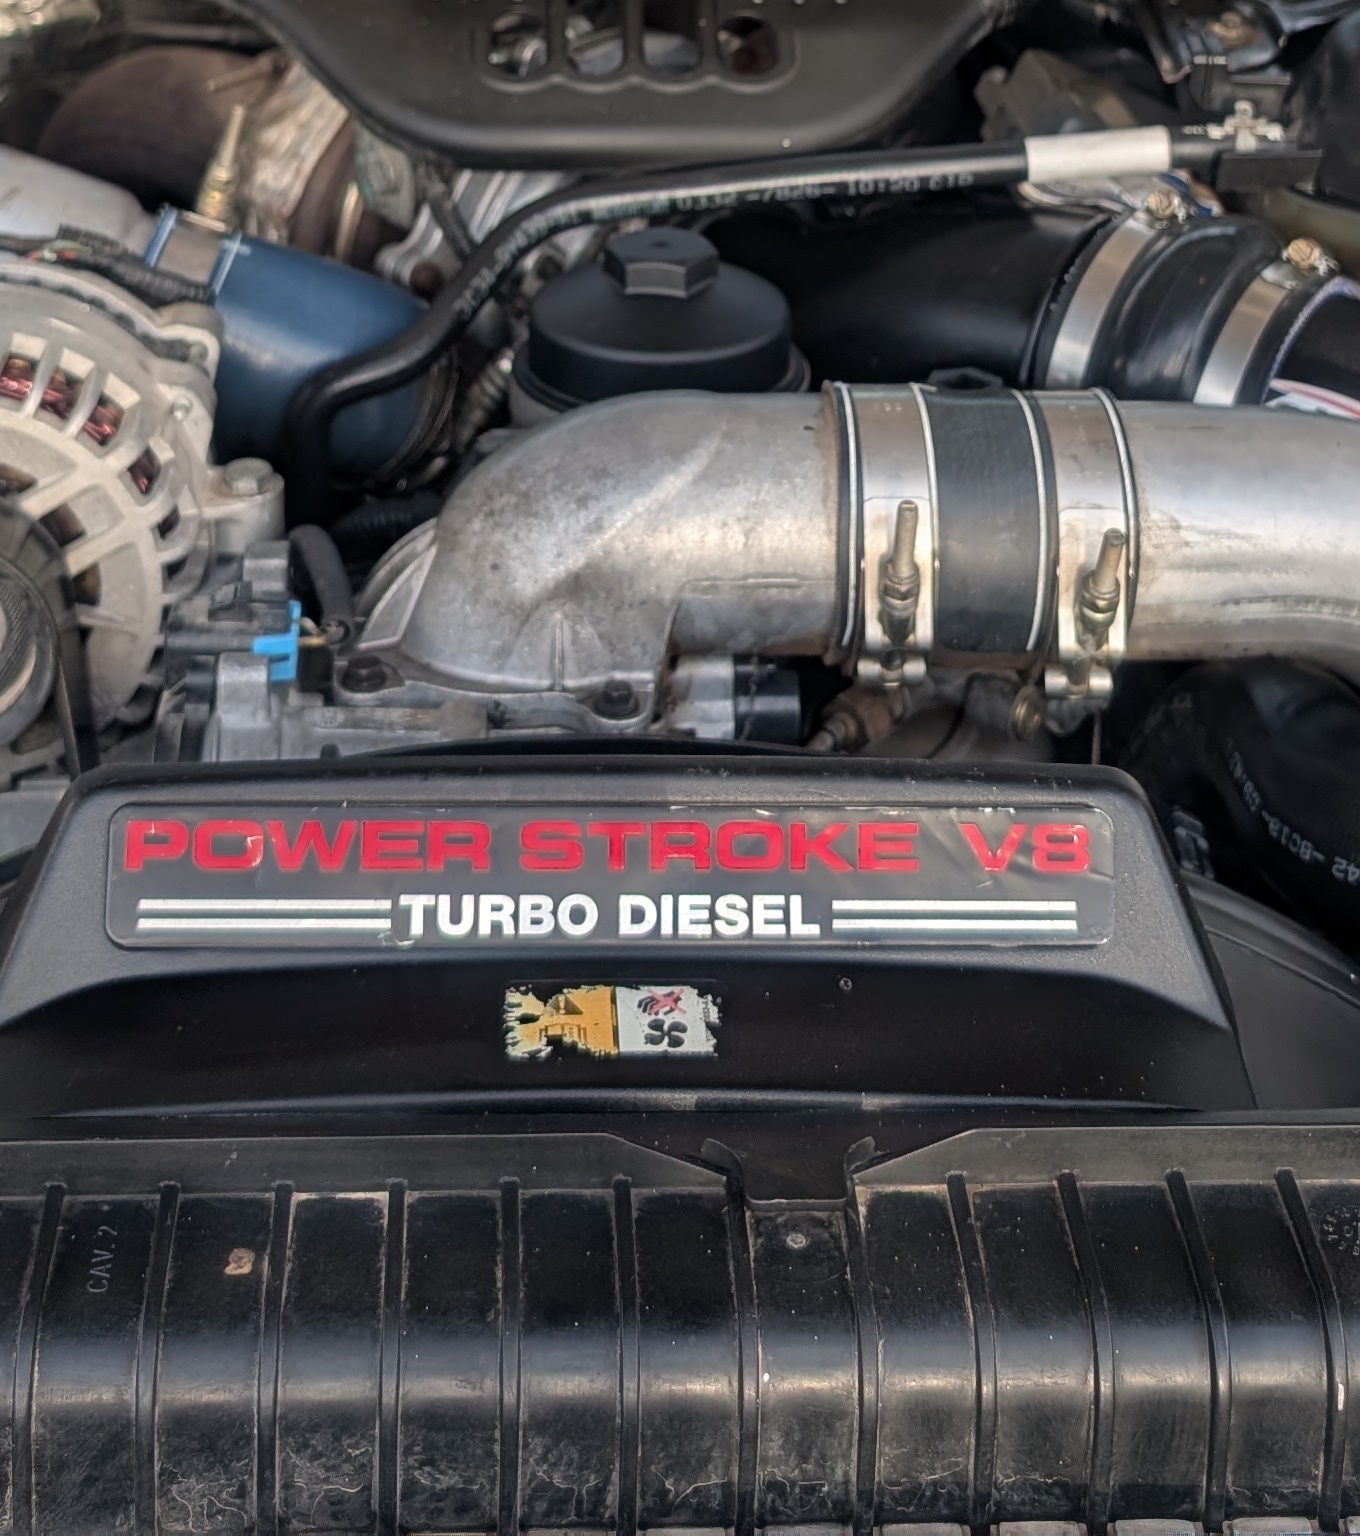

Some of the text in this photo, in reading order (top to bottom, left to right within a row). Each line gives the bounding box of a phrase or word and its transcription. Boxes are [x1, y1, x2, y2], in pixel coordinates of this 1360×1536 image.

[123, 820, 1092, 873] POWER STROKE V8
[400, 894, 821, 939] TURBO DIESEL
